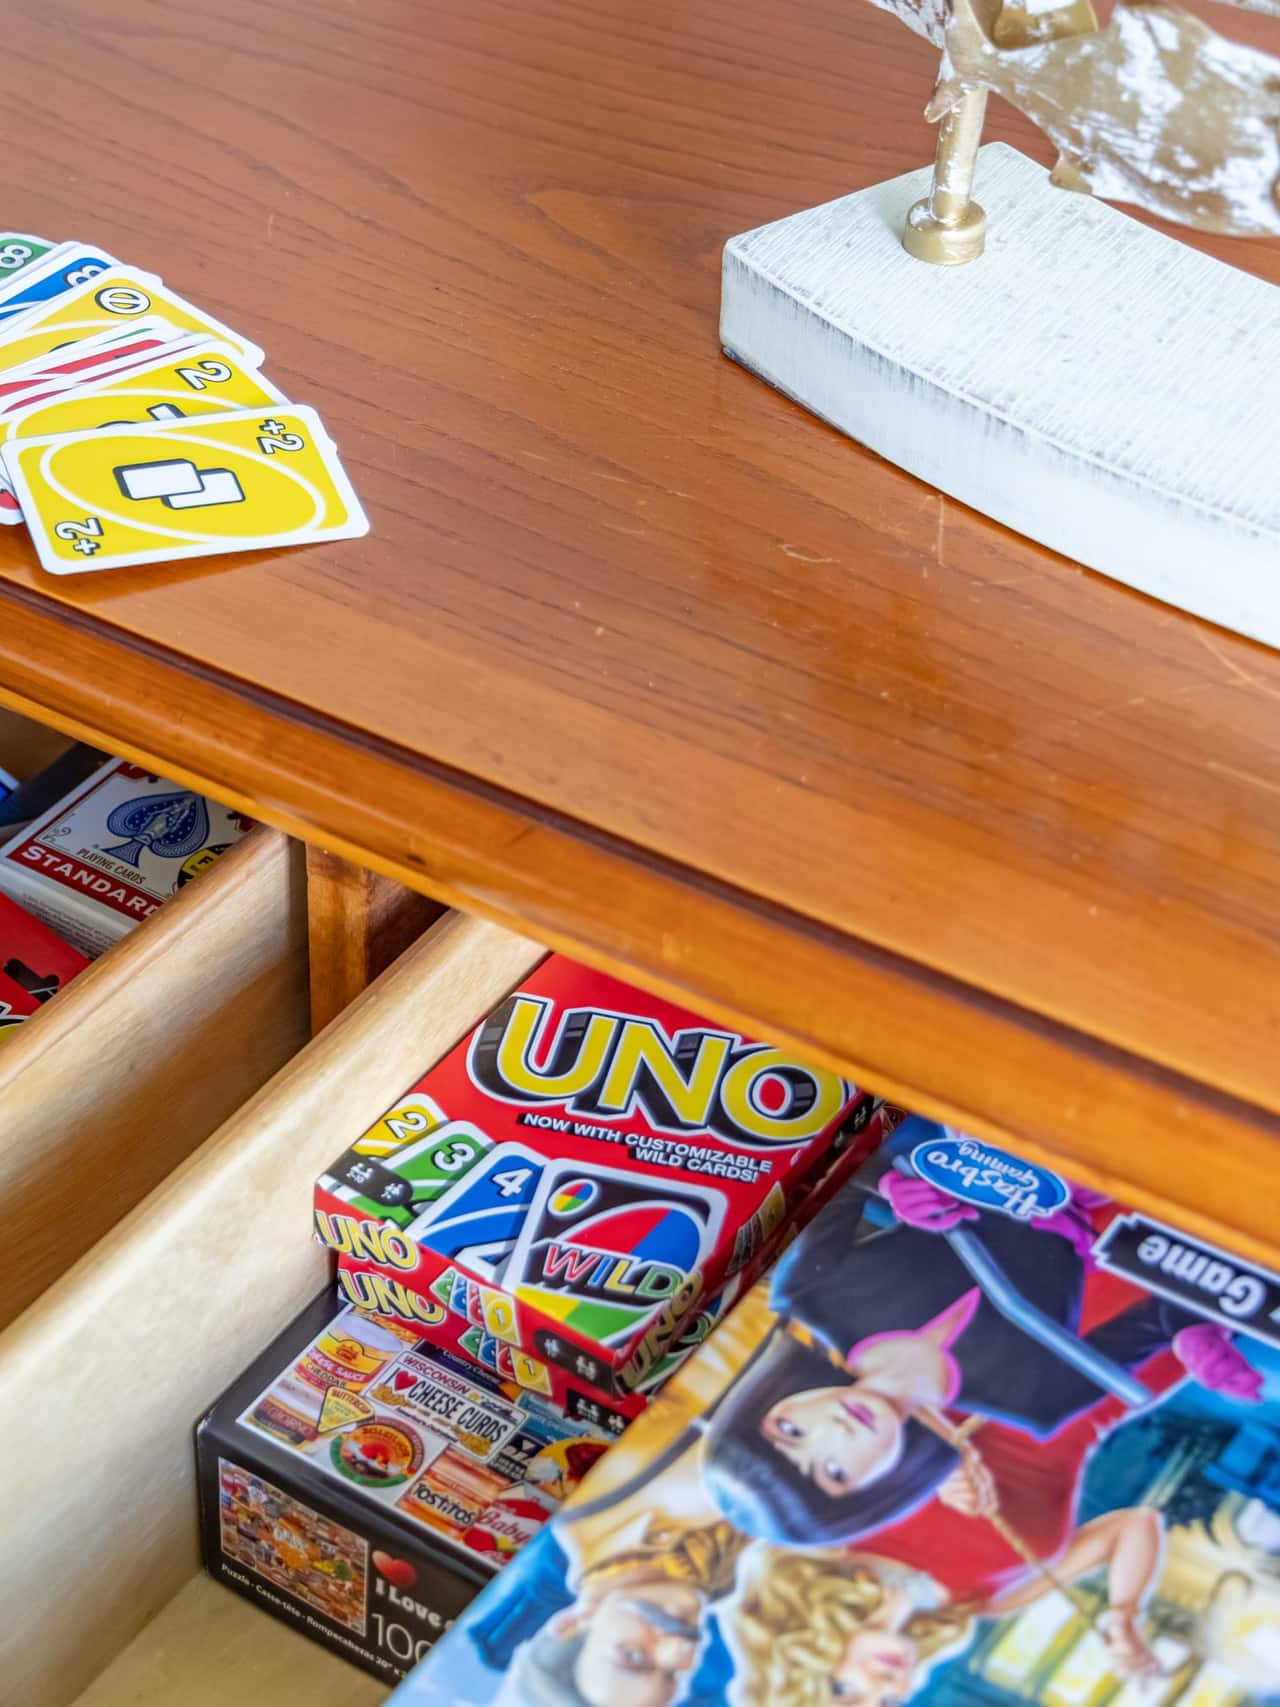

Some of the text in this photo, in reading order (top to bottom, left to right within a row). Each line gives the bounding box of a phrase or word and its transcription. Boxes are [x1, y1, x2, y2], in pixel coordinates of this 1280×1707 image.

[175, 361, 232, 390] 2
[257, 418, 304, 455] +2
[54, 517, 104, 555] +2
[76, 847, 147, 886] PLAYING CARDS
[485, 995, 850, 1146] UNO
[386, 1111, 428, 1139] 2
[523, 1113, 773, 1173] NOW WITH CUSTOMIZABLE
[432, 1142, 476, 1172] 3
[635, 1147, 760, 1183] WILD CARDS!
[959, 1140, 1040, 1191] Gaming
[491, 1168, 534, 1198] 4
[926, 1151, 1039, 1217] Hasbro
[316, 1211, 420, 1270] UNO
[542, 1244, 684, 1299] WILD
[1137, 1235, 1268, 1318] Game
[340, 1270, 447, 1326] UNO
[493, 1309, 505, 1327] 1
[306, 1362, 347, 1388] CHEDDAR
[404, 1355, 470, 1394] WISCONSIN
[408, 1380, 464, 1420] CHEESE
[457, 1403, 509, 1442] CURDS
[479, 1506, 532, 1544] Baby
[221, 1563, 250, 1588] Puzzle
[389, 1584, 442, 1628] Love
